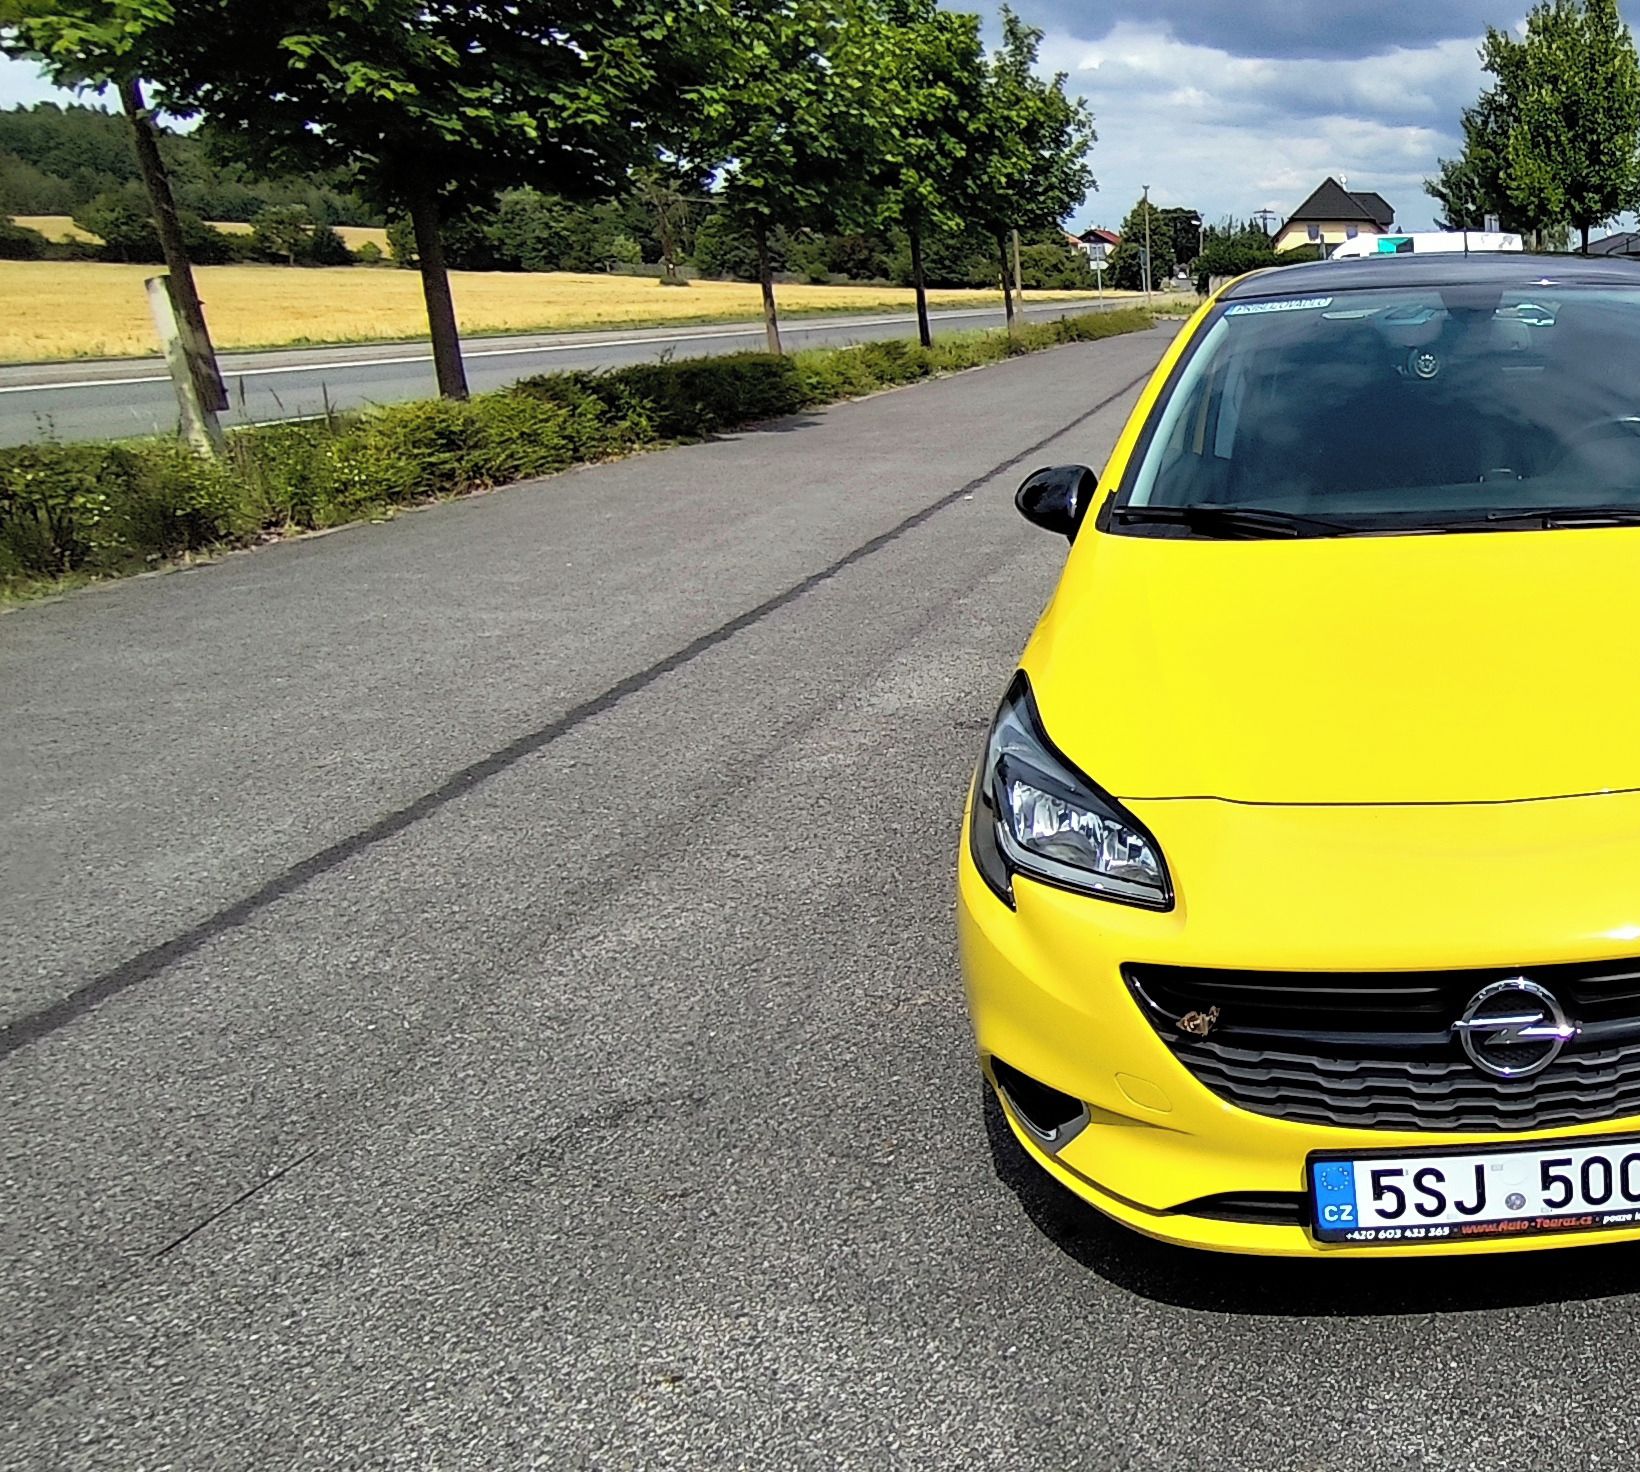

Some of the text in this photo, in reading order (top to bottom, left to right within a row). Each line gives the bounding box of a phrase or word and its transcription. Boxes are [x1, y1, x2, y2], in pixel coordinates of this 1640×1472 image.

[1370, 1164, 1487, 1219] 5SJ
[1324, 1203, 1354, 1223] CZ
[1346, 1230, 1375, 1240] +420
[1378, 1228, 1402, 1239] 603
[1602, 1213, 1633, 1225] pouze
